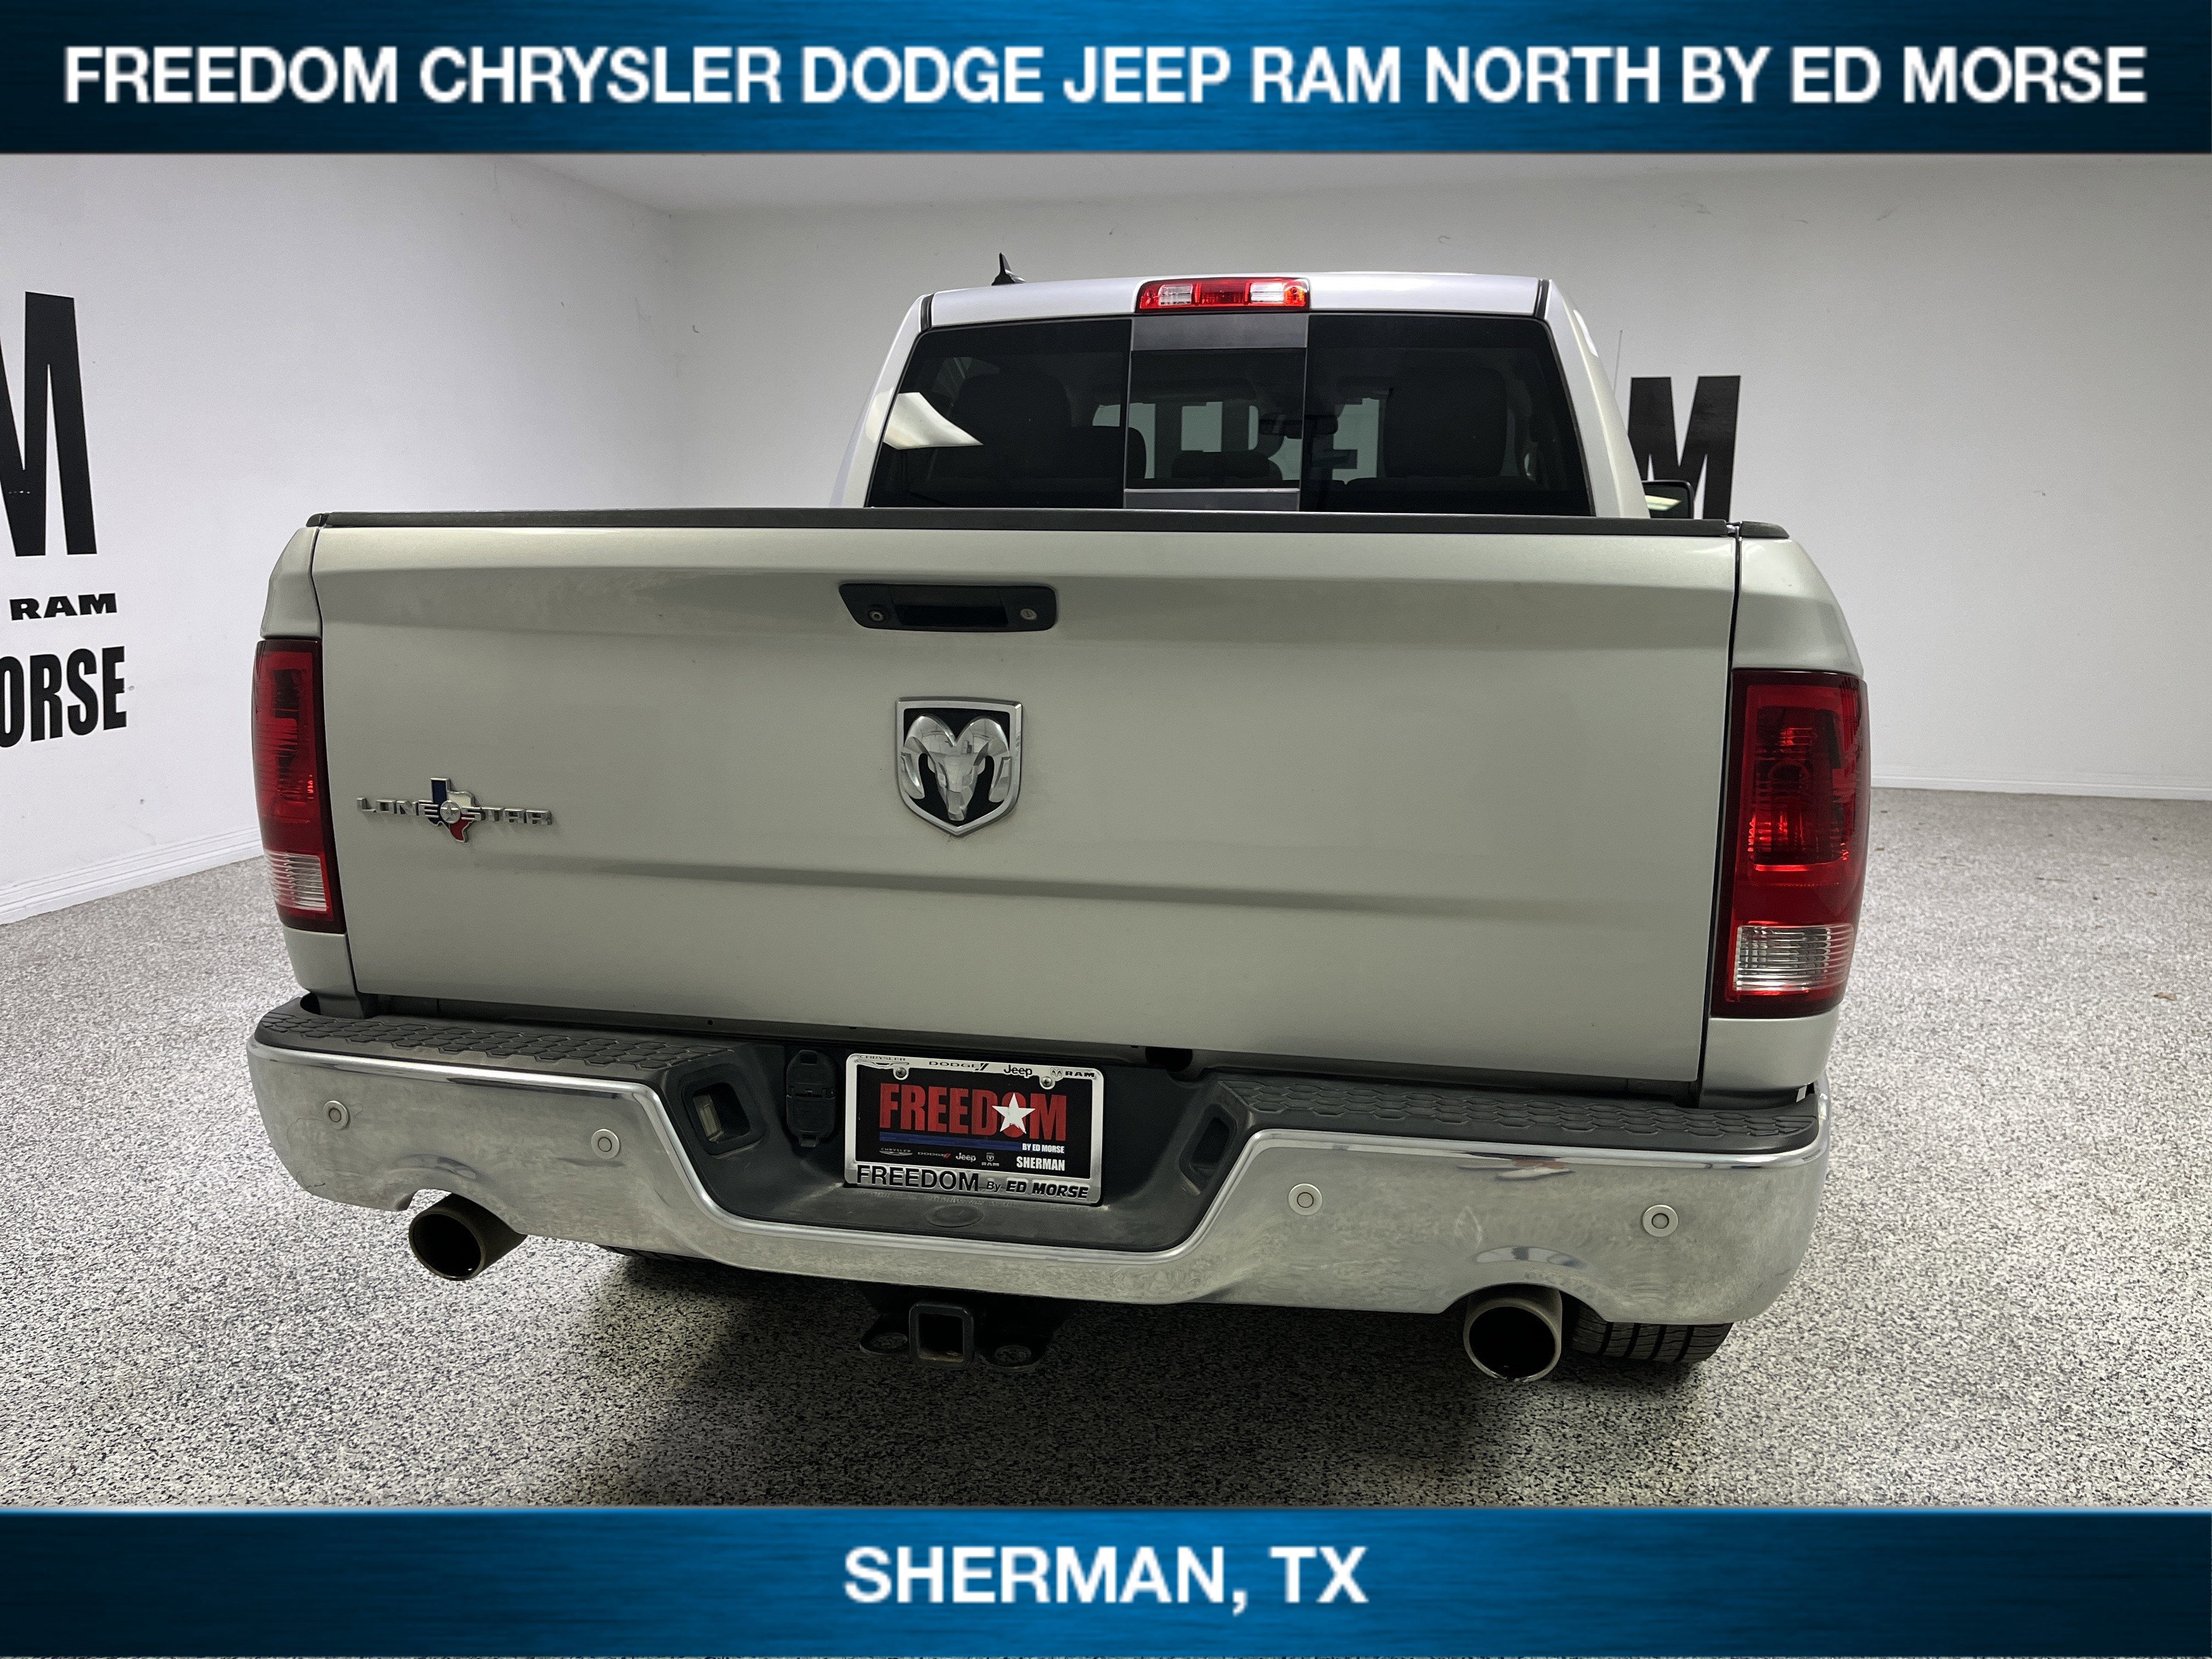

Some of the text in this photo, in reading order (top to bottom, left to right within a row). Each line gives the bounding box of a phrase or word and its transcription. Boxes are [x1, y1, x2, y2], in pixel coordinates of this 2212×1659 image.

[9, 592, 117, 620] RAM
[356, 797, 552, 825] LONE STAR
[928, 1060, 983, 1069] DODGE
[1003, 1064, 1033, 1077] Jeep
[879, 1082, 1067, 1142] FREEDOM
[955, 1152, 977, 1163] Jeep
[1022, 1143, 1031, 1151] BY
[1041, 1145, 1065, 1154] MORSE
[1016, 1156, 1066, 1171] SHERMAN
[856, 1165, 1090, 1199] FREEDOM By ED MORSE
